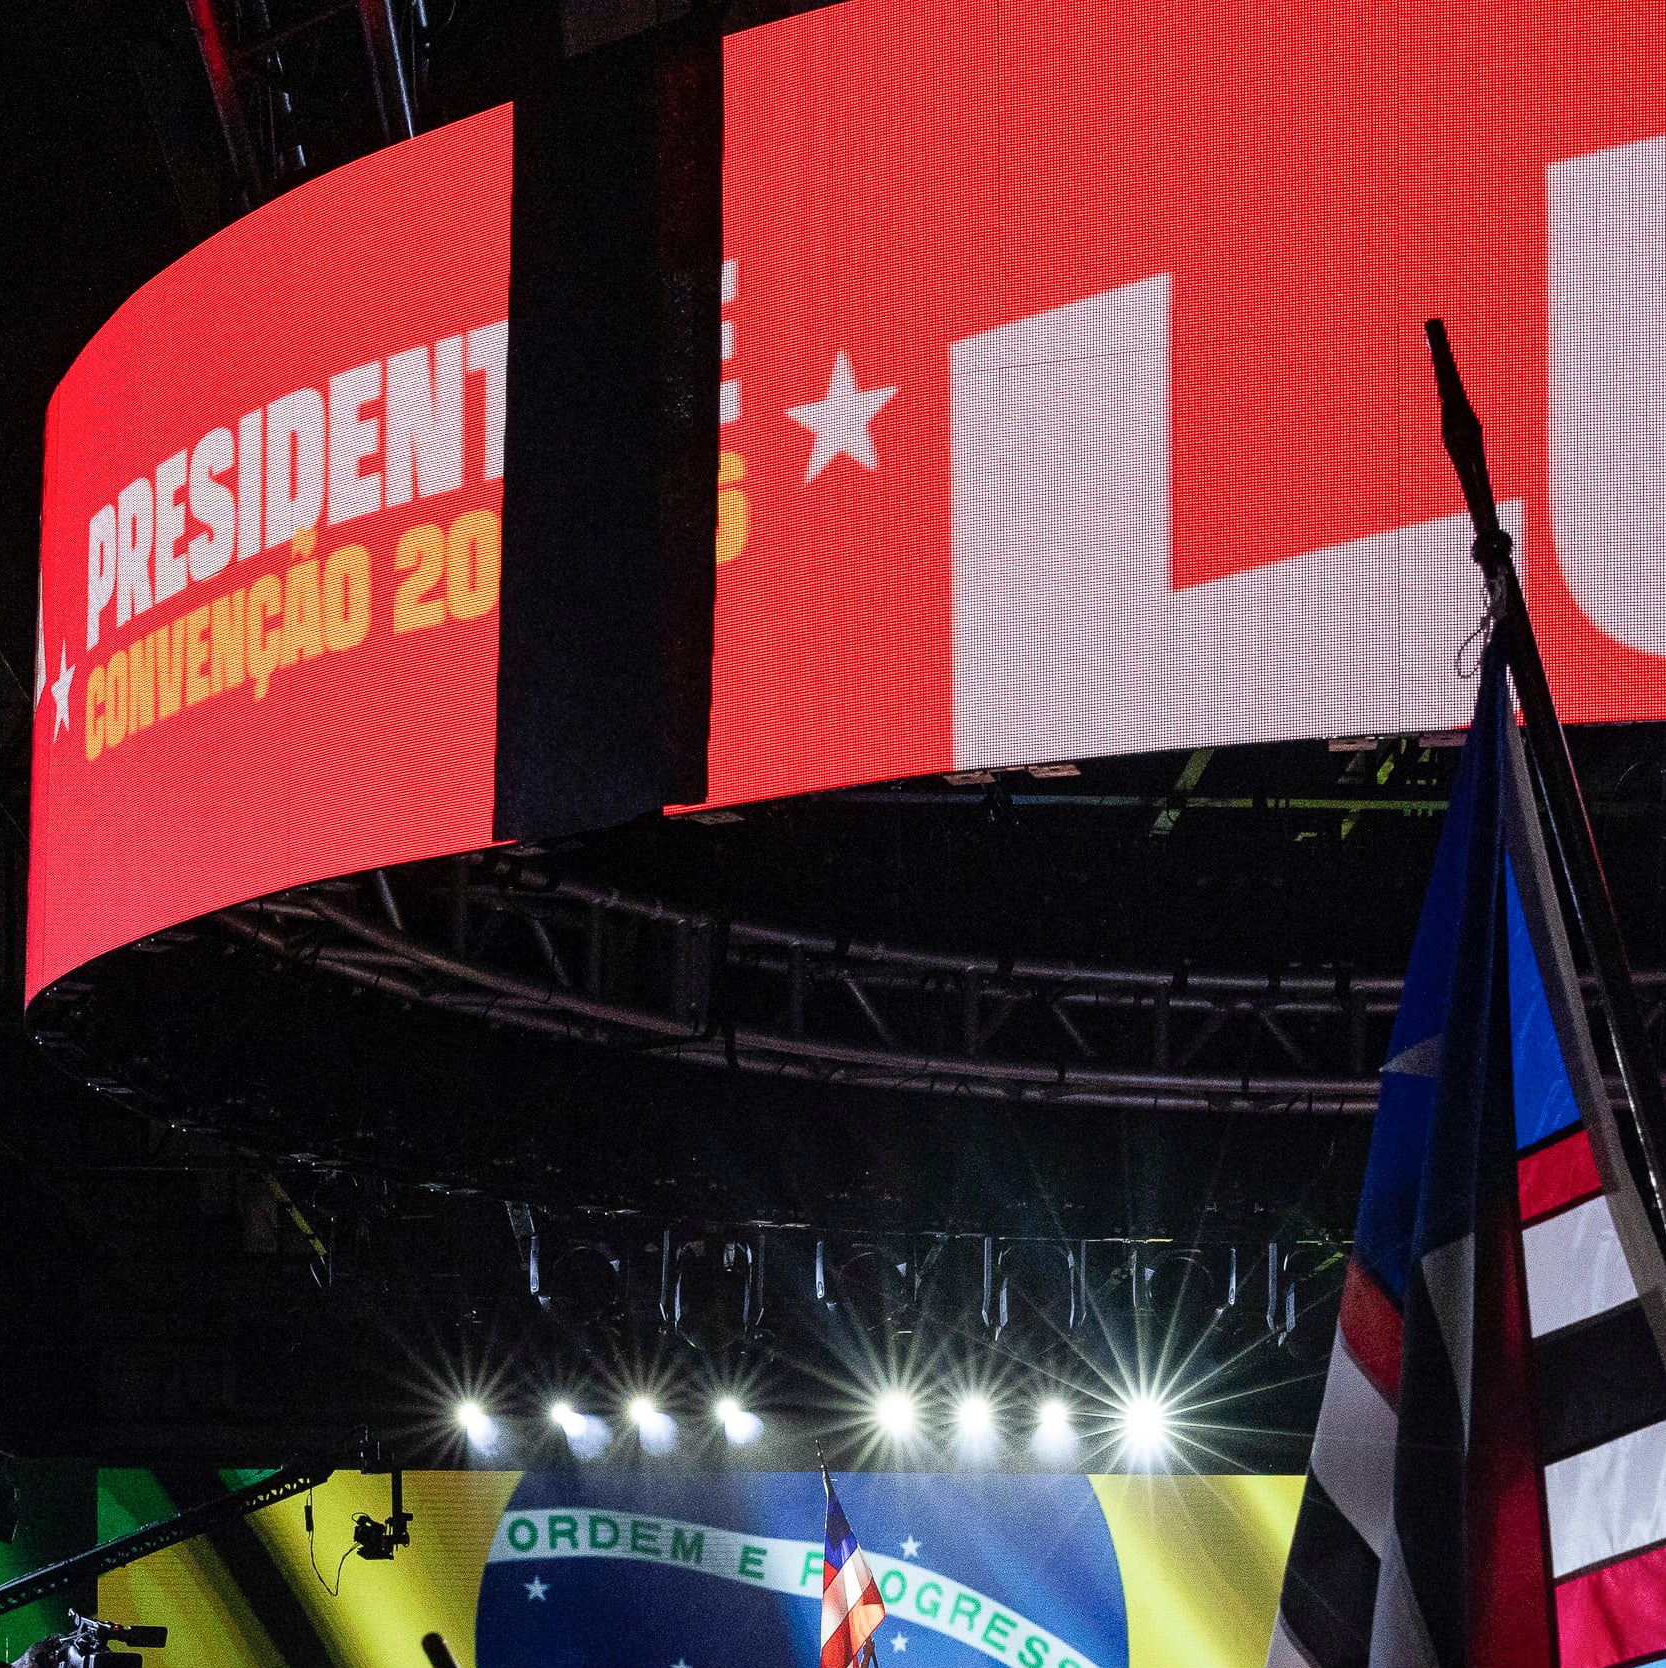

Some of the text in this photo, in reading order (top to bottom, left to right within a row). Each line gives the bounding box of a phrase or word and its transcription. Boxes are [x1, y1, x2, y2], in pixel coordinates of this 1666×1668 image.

[86, 258, 741, 652] PRESIDENT
[84, 527, 373, 761] CONVENÇÃO
[507, 1514, 704, 1564] ORDEM
[737, 1545, 768, 1580] E
